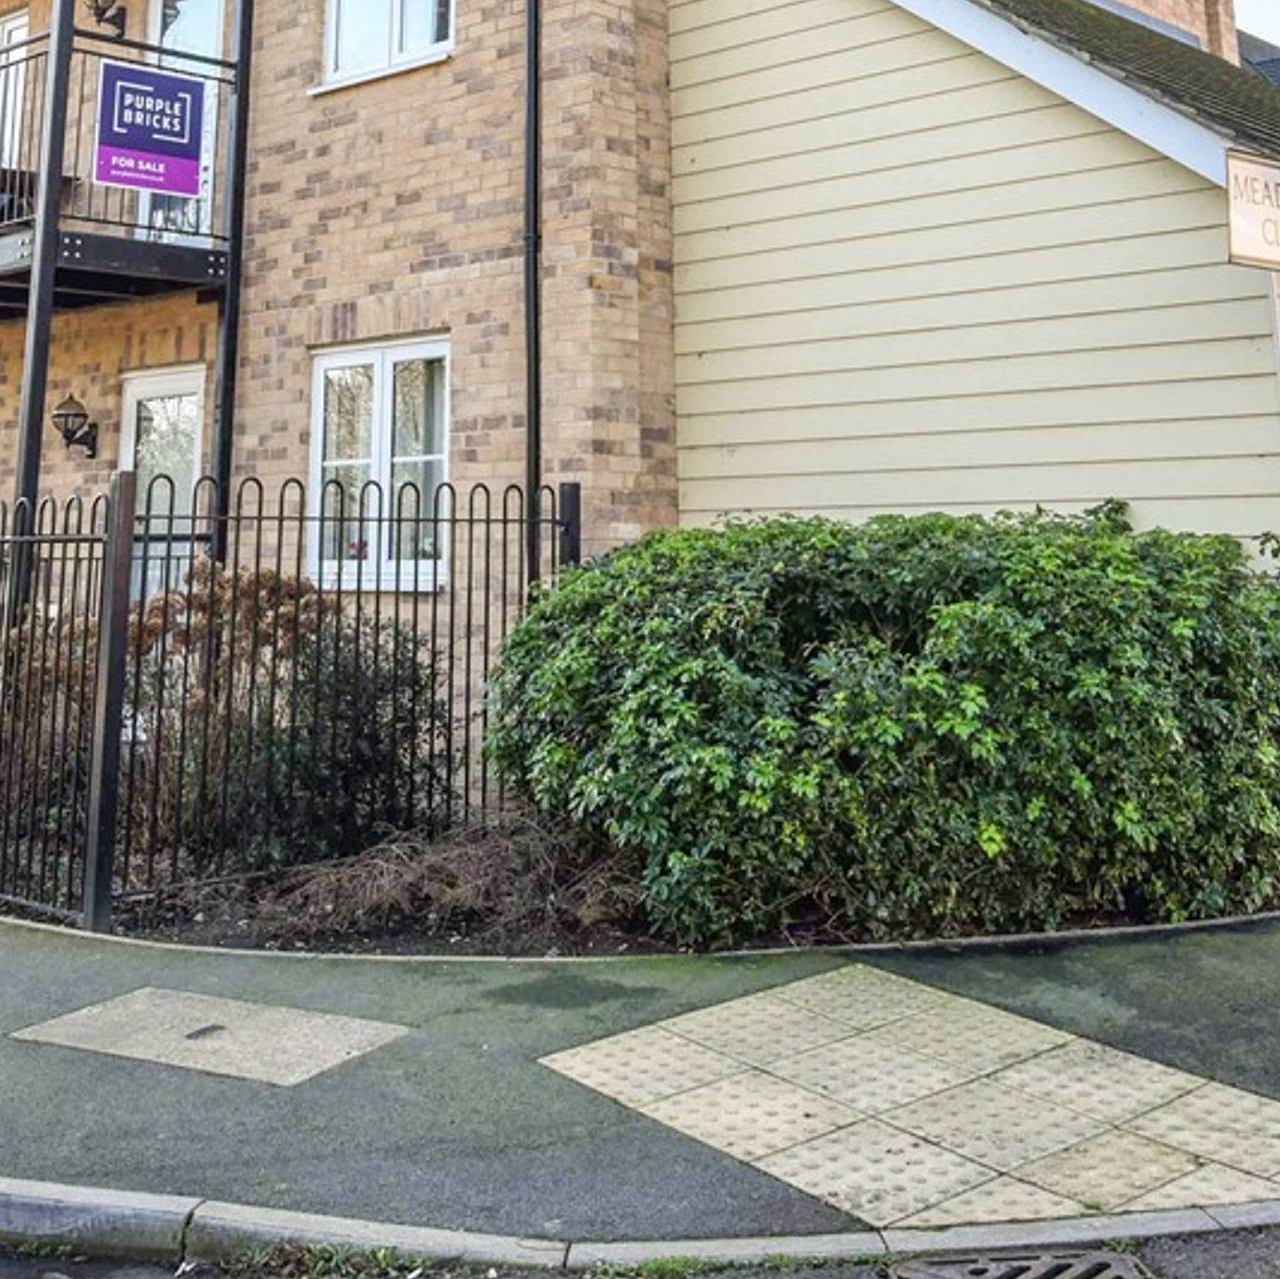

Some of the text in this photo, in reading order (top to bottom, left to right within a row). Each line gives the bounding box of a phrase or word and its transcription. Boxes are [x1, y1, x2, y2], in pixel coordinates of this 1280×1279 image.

[124, 93, 182, 116] PURPLE
[123, 109, 181, 131] BRICKS
[112, 156, 165, 173] FOR SALE
